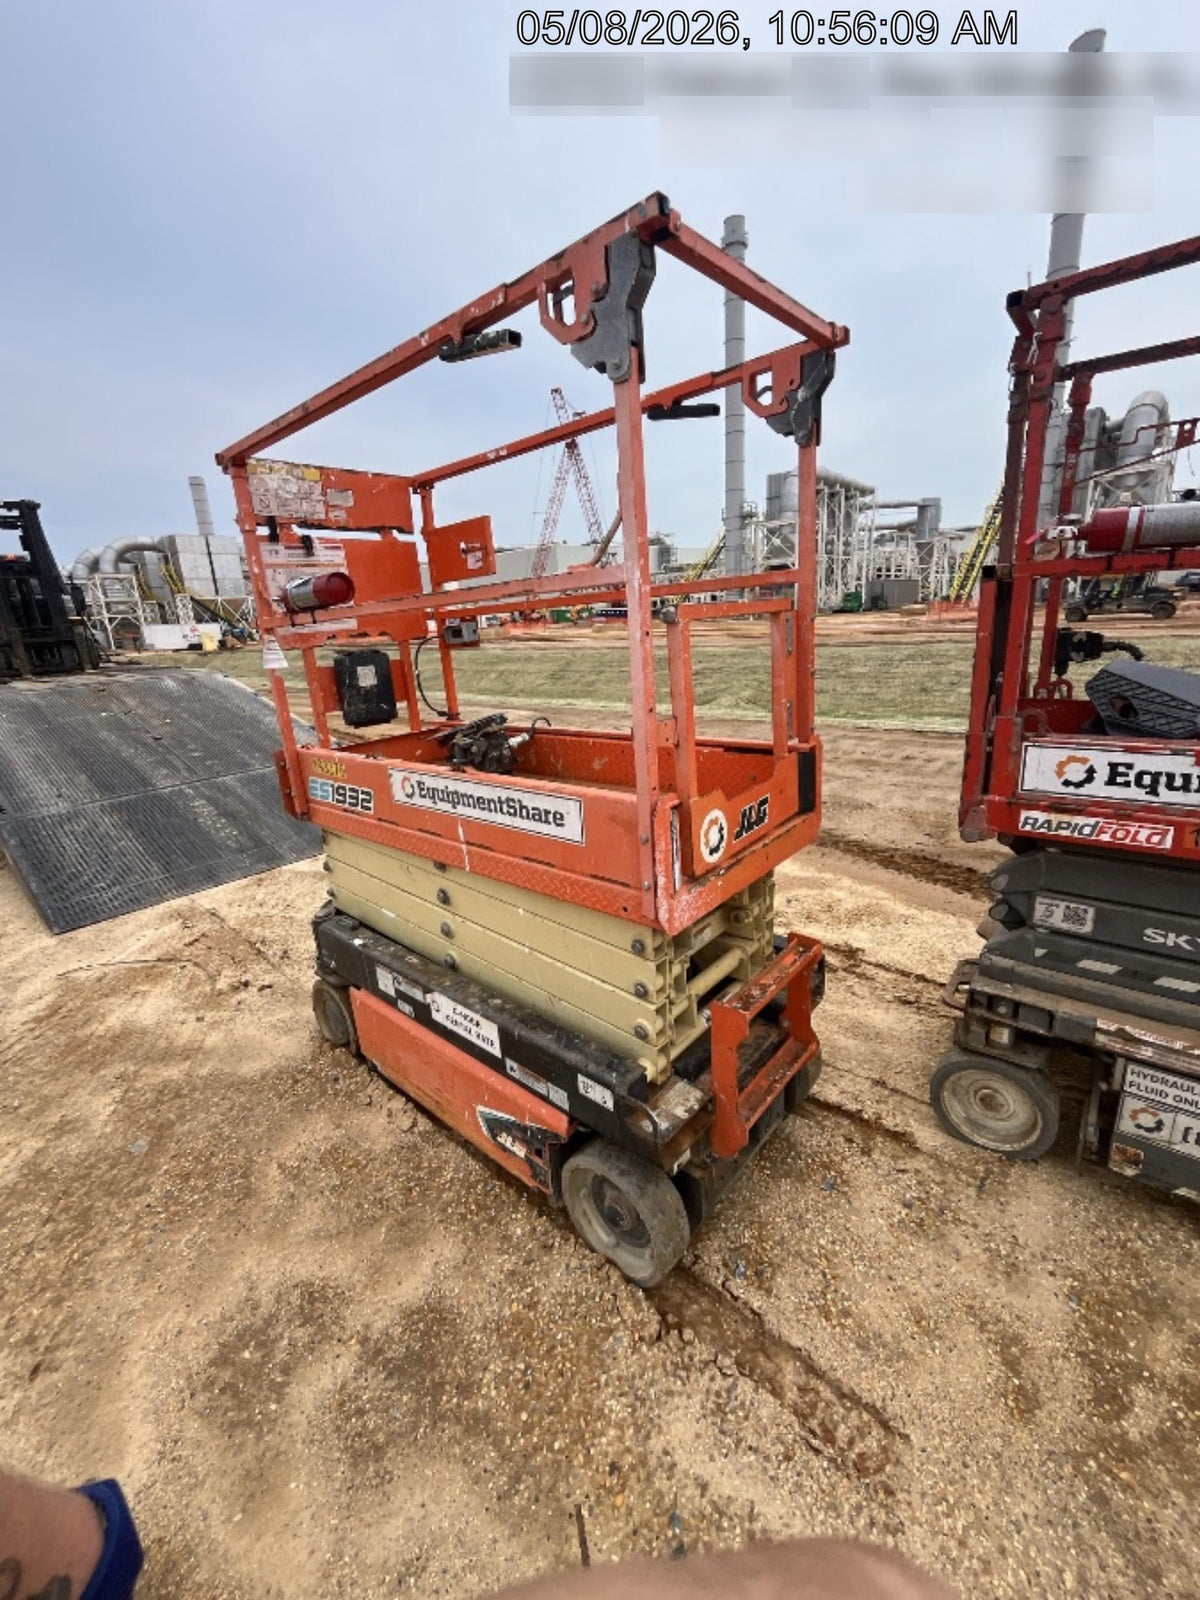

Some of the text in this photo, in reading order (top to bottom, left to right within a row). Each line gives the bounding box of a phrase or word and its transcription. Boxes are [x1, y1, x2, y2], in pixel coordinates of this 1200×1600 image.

[309, 778, 373, 812] ES1932
[416, 780, 566, 828] EquipmentShare
[732, 793, 769, 843] JLG
[1143, 927, 1200, 951] SK
[1128, 1081, 1169, 1100] FLUID
[1130, 1068, 1200, 1096] HYDRAUL
